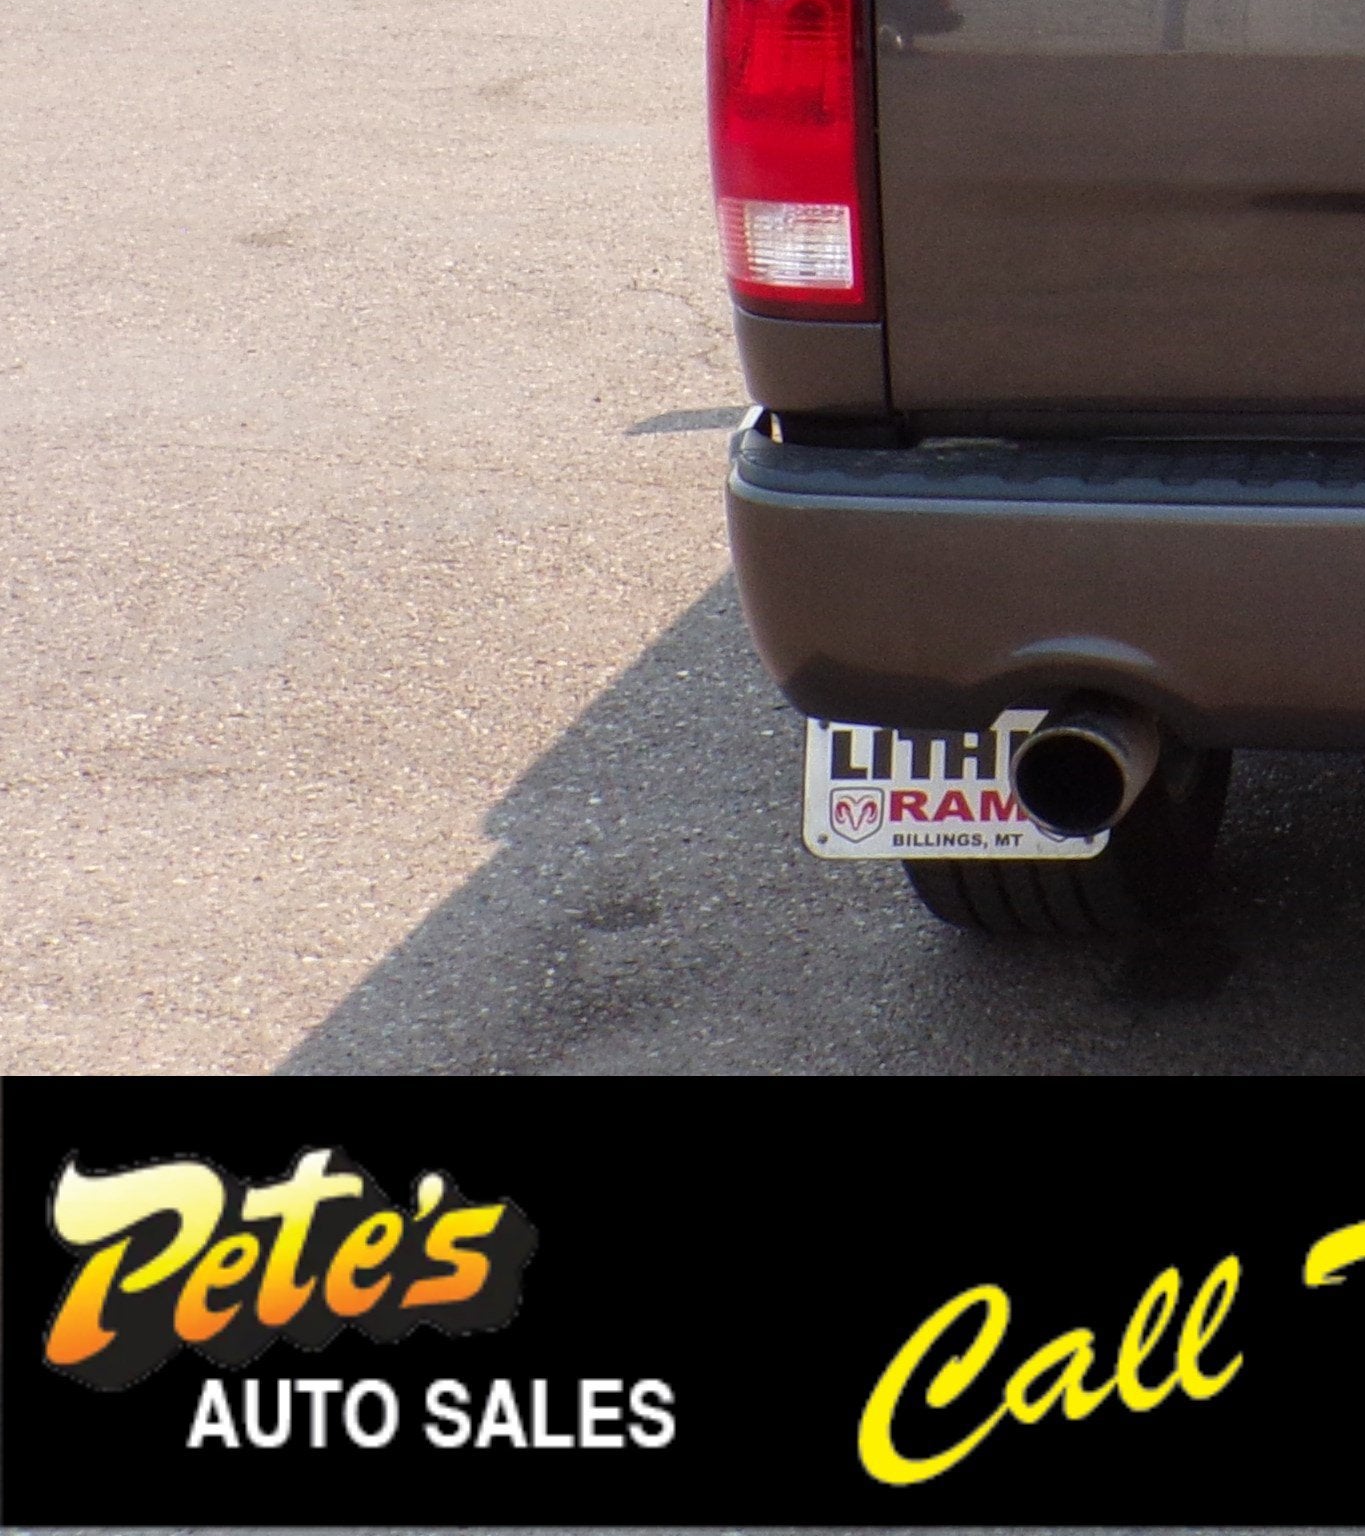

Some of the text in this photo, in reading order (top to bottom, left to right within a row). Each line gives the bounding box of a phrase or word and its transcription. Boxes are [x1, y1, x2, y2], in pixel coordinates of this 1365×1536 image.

[830, 729, 1033, 780] LITH
[889, 789, 1030, 822] RAM
[892, 832, 1025, 850] BILLINGS, MT
